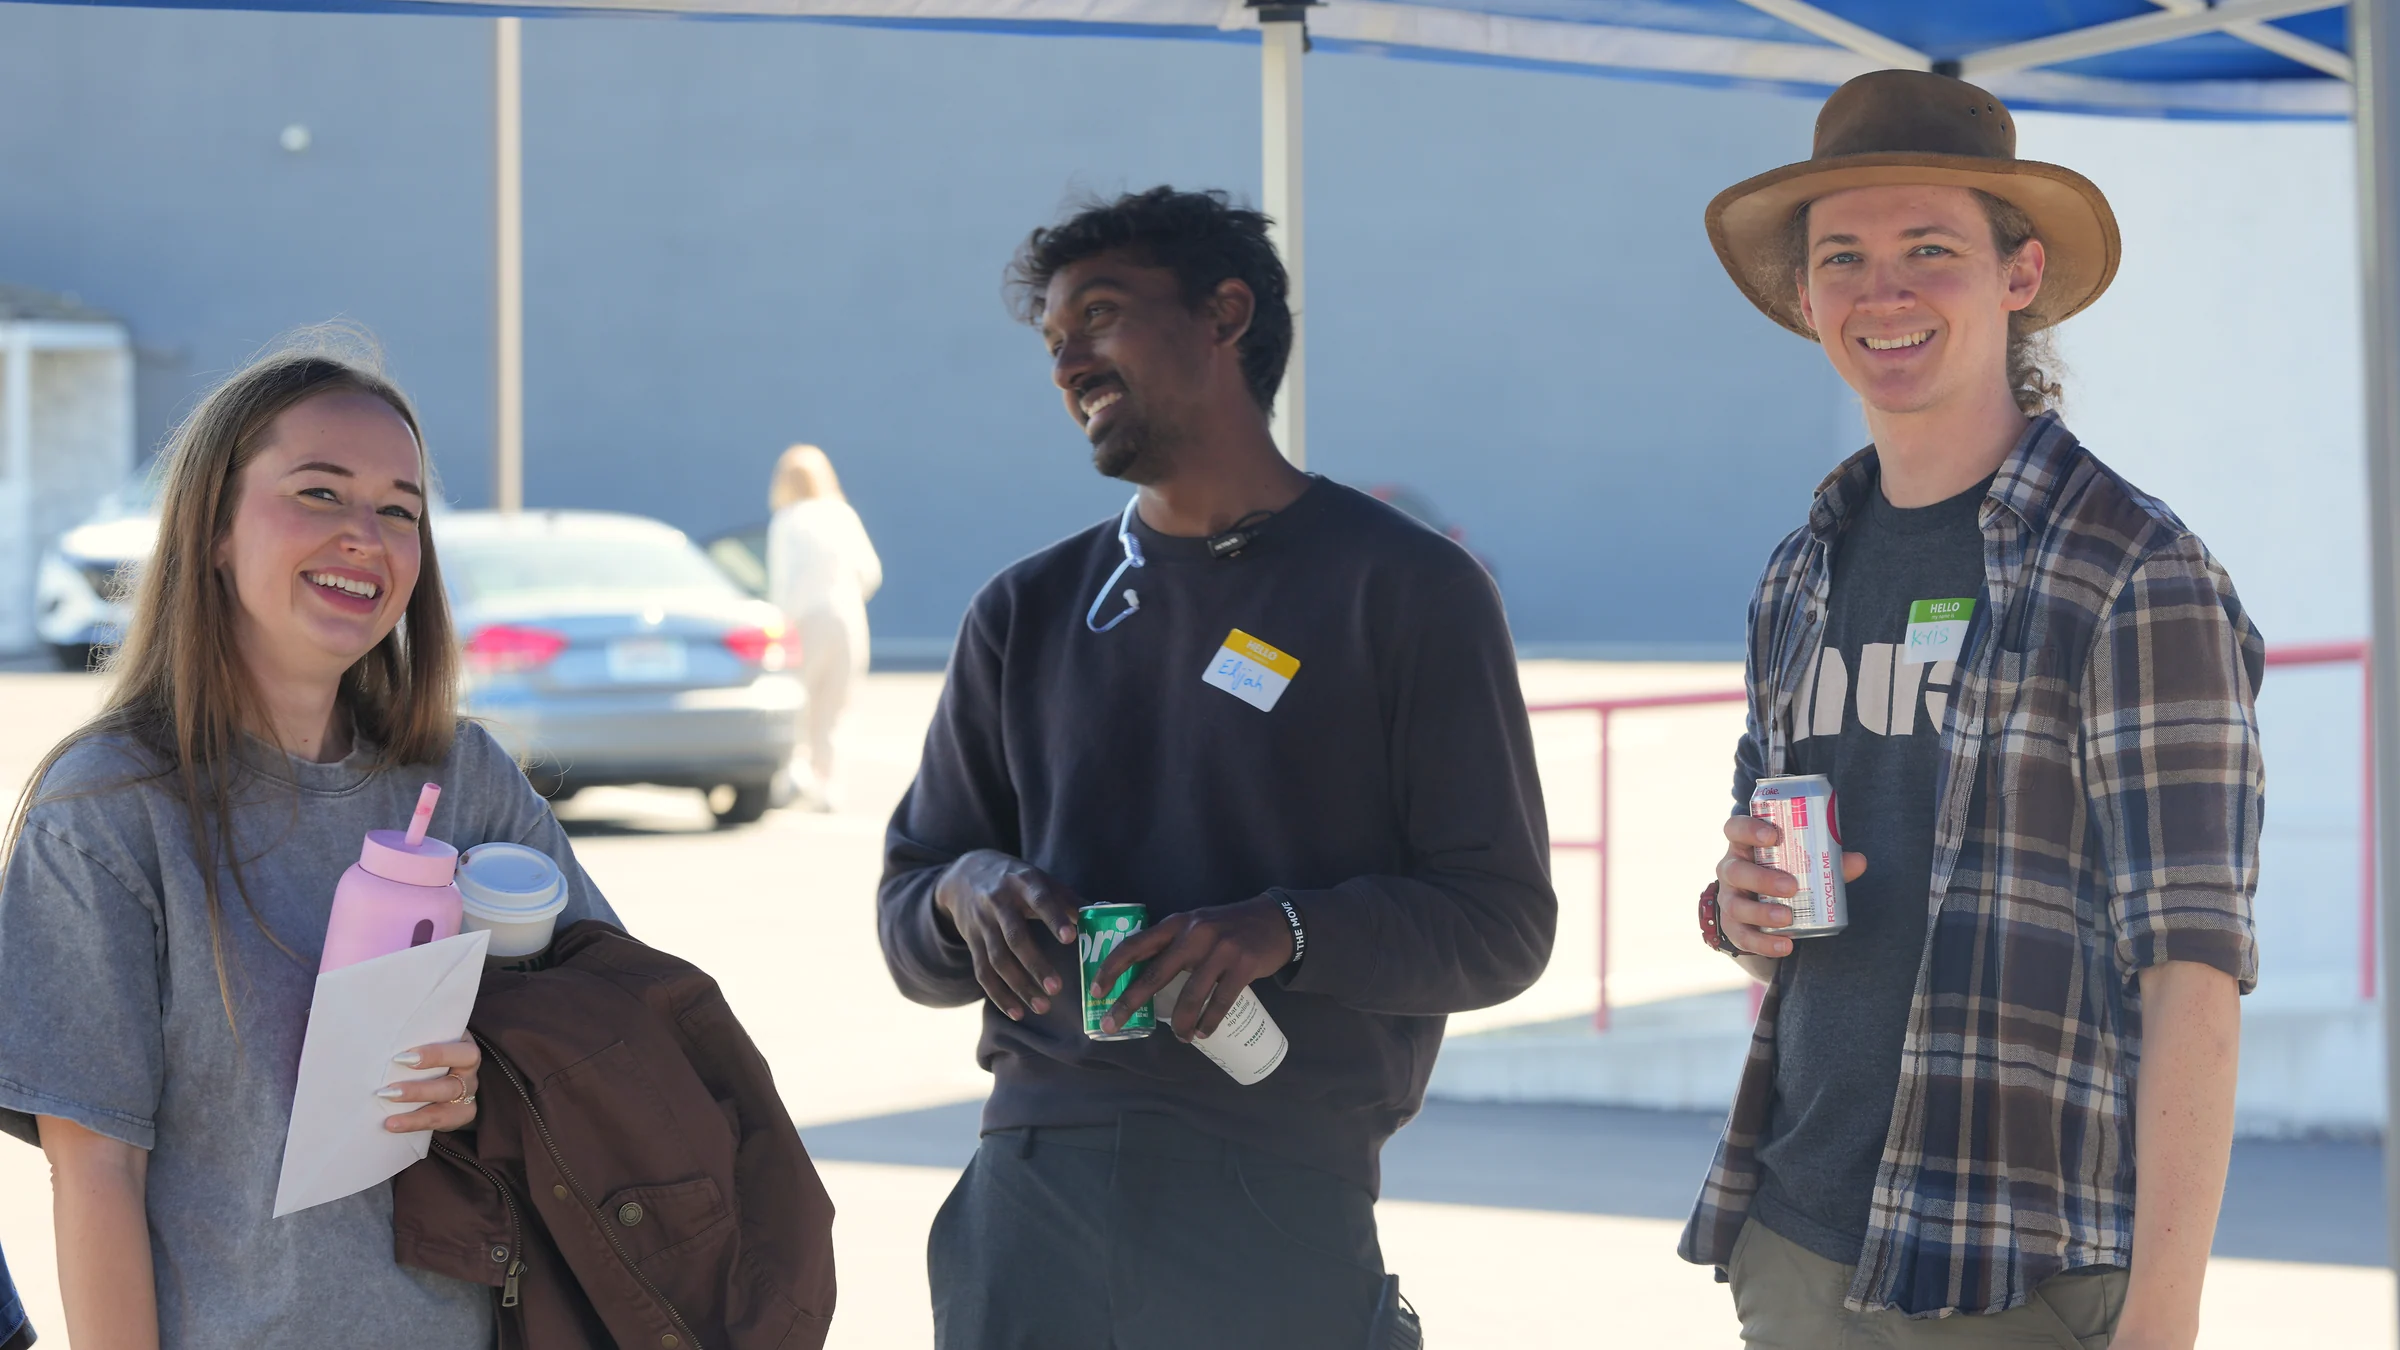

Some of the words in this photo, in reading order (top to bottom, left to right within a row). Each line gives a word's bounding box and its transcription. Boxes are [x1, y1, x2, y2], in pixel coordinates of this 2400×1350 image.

[1930, 602, 1960, 613] HELLO
[1246, 640, 1278, 661] HELLO
[1822, 851, 1831, 869] ME
[1824, 871, 1836, 923] RECYCLE
[1281, 901, 1301, 927] MOVE
[1294, 928, 1305, 951] THE
[1227, 1019, 1237, 1028] sip
